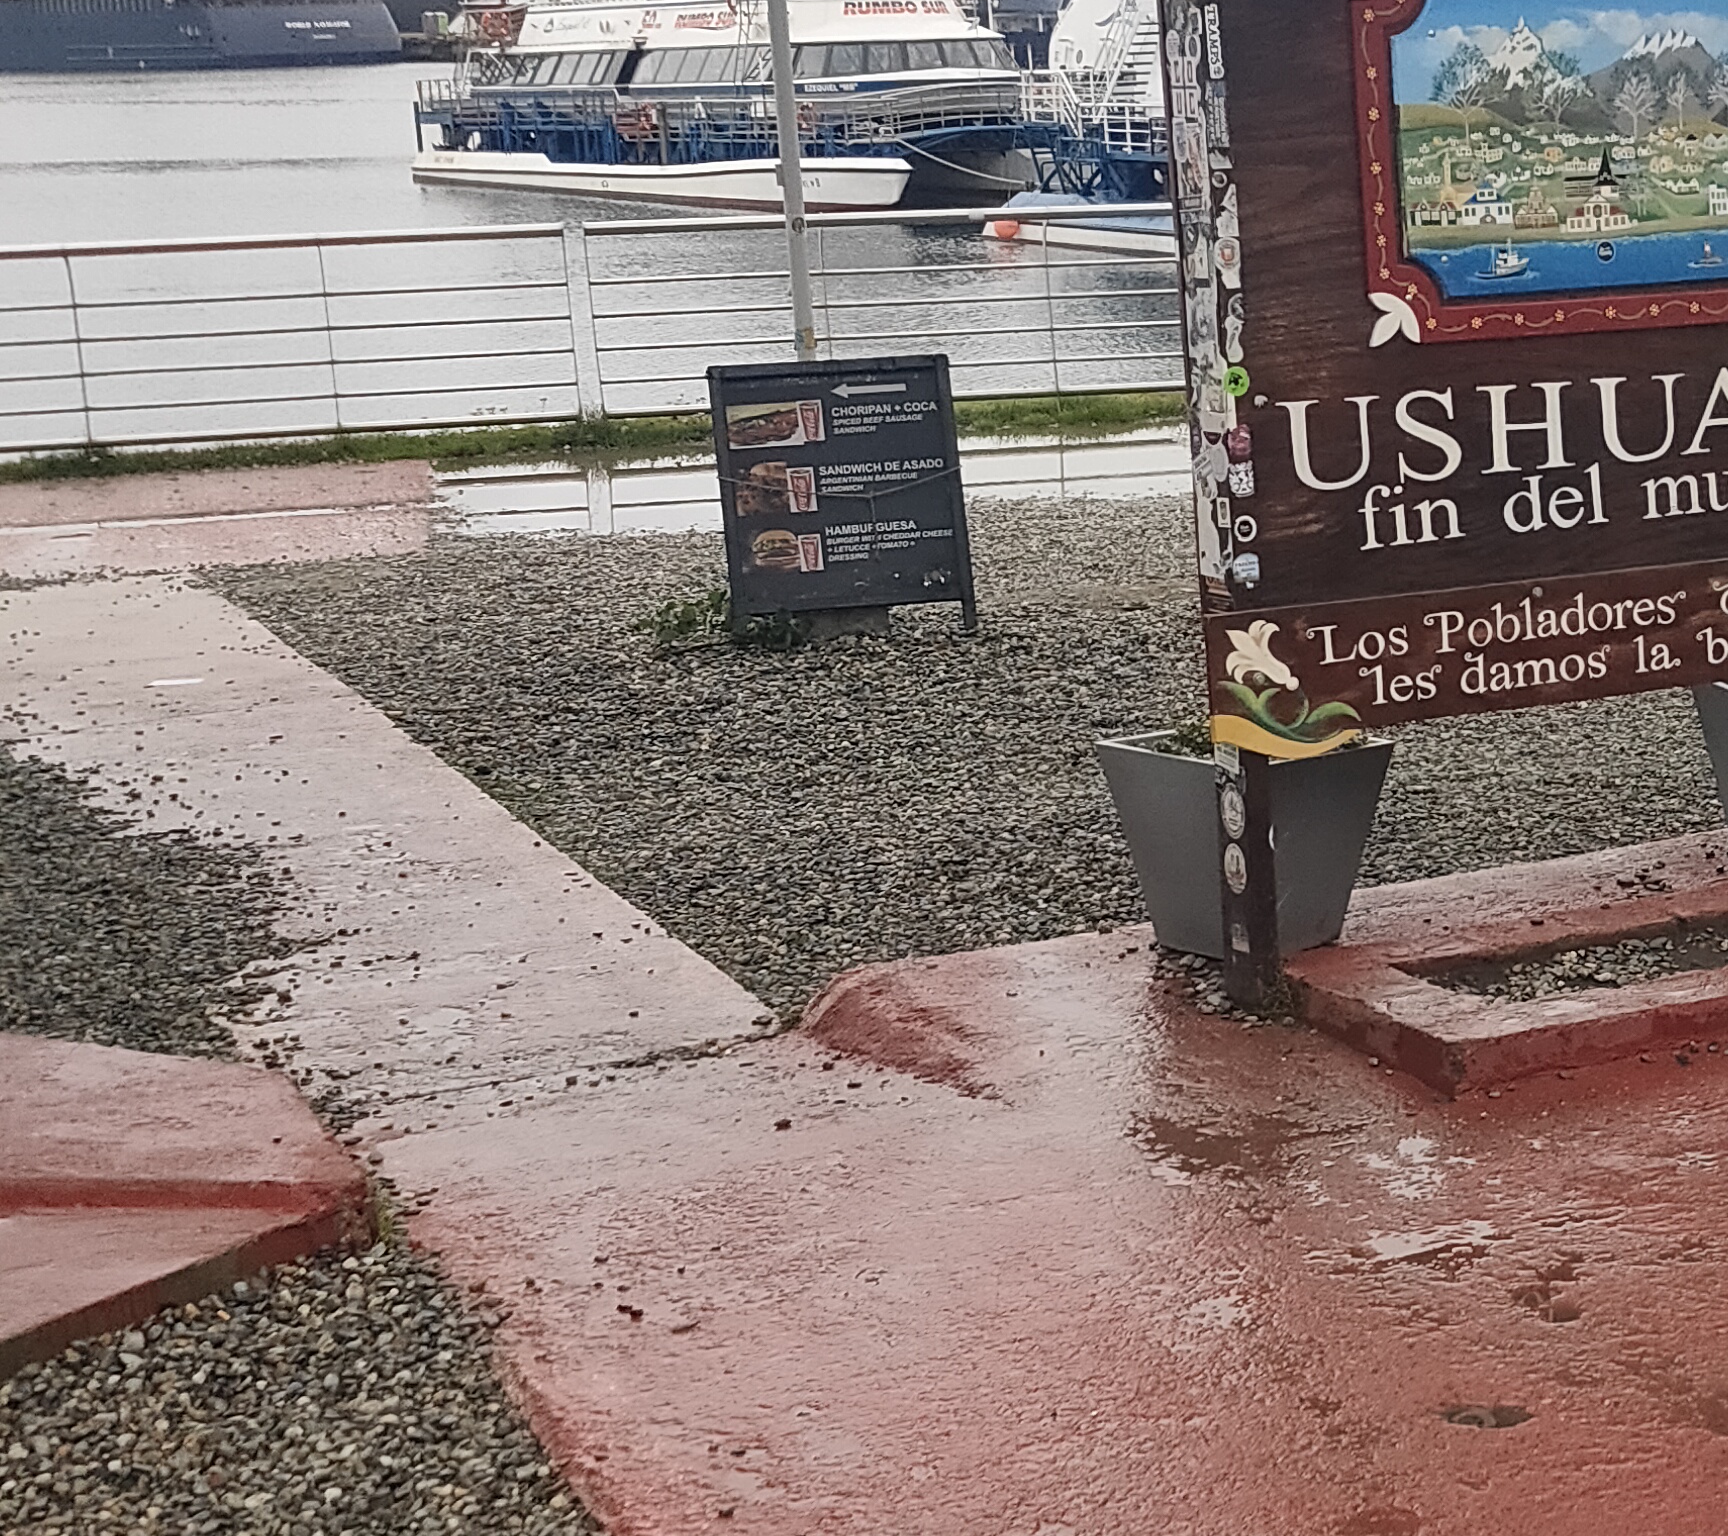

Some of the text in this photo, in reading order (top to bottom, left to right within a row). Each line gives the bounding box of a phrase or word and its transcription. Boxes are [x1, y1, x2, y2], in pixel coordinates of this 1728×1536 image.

[843, 0, 950, 16] RUMBO SUR
[1206, 7, 1220, 66] TRAMPS
[831, 404, 892, 417] CHORIPAN
[903, 401, 938, 412] COCA
[832, 413, 923, 426] SPICED BEEF SAUSAGE
[832, 425, 877, 435] SANDWICH
[818, 458, 944, 476] SANDWICH DE ASADO
[820, 471, 918, 485] ARGENTINIAN BARBECUE
[820, 484, 864, 493] SANDWICH
[1358, 484, 1466, 551] fin
[1503, 462, 1610, 533] del
[826, 536, 860, 545] BURGER
[883, 531, 921, 540] CHEDDAR
[922, 529, 953, 537] CHEESE
[834, 544, 871, 553] LETUCCE
[828, 552, 869, 562] DRESSING
[1306, 623, 1410, 666] Los
[1423, 590, 1687, 655] Pobladores
[1359, 663, 1442, 706] les
[1459, 644, 1611, 695] damos
[1632, 634, 1682, 674] la
